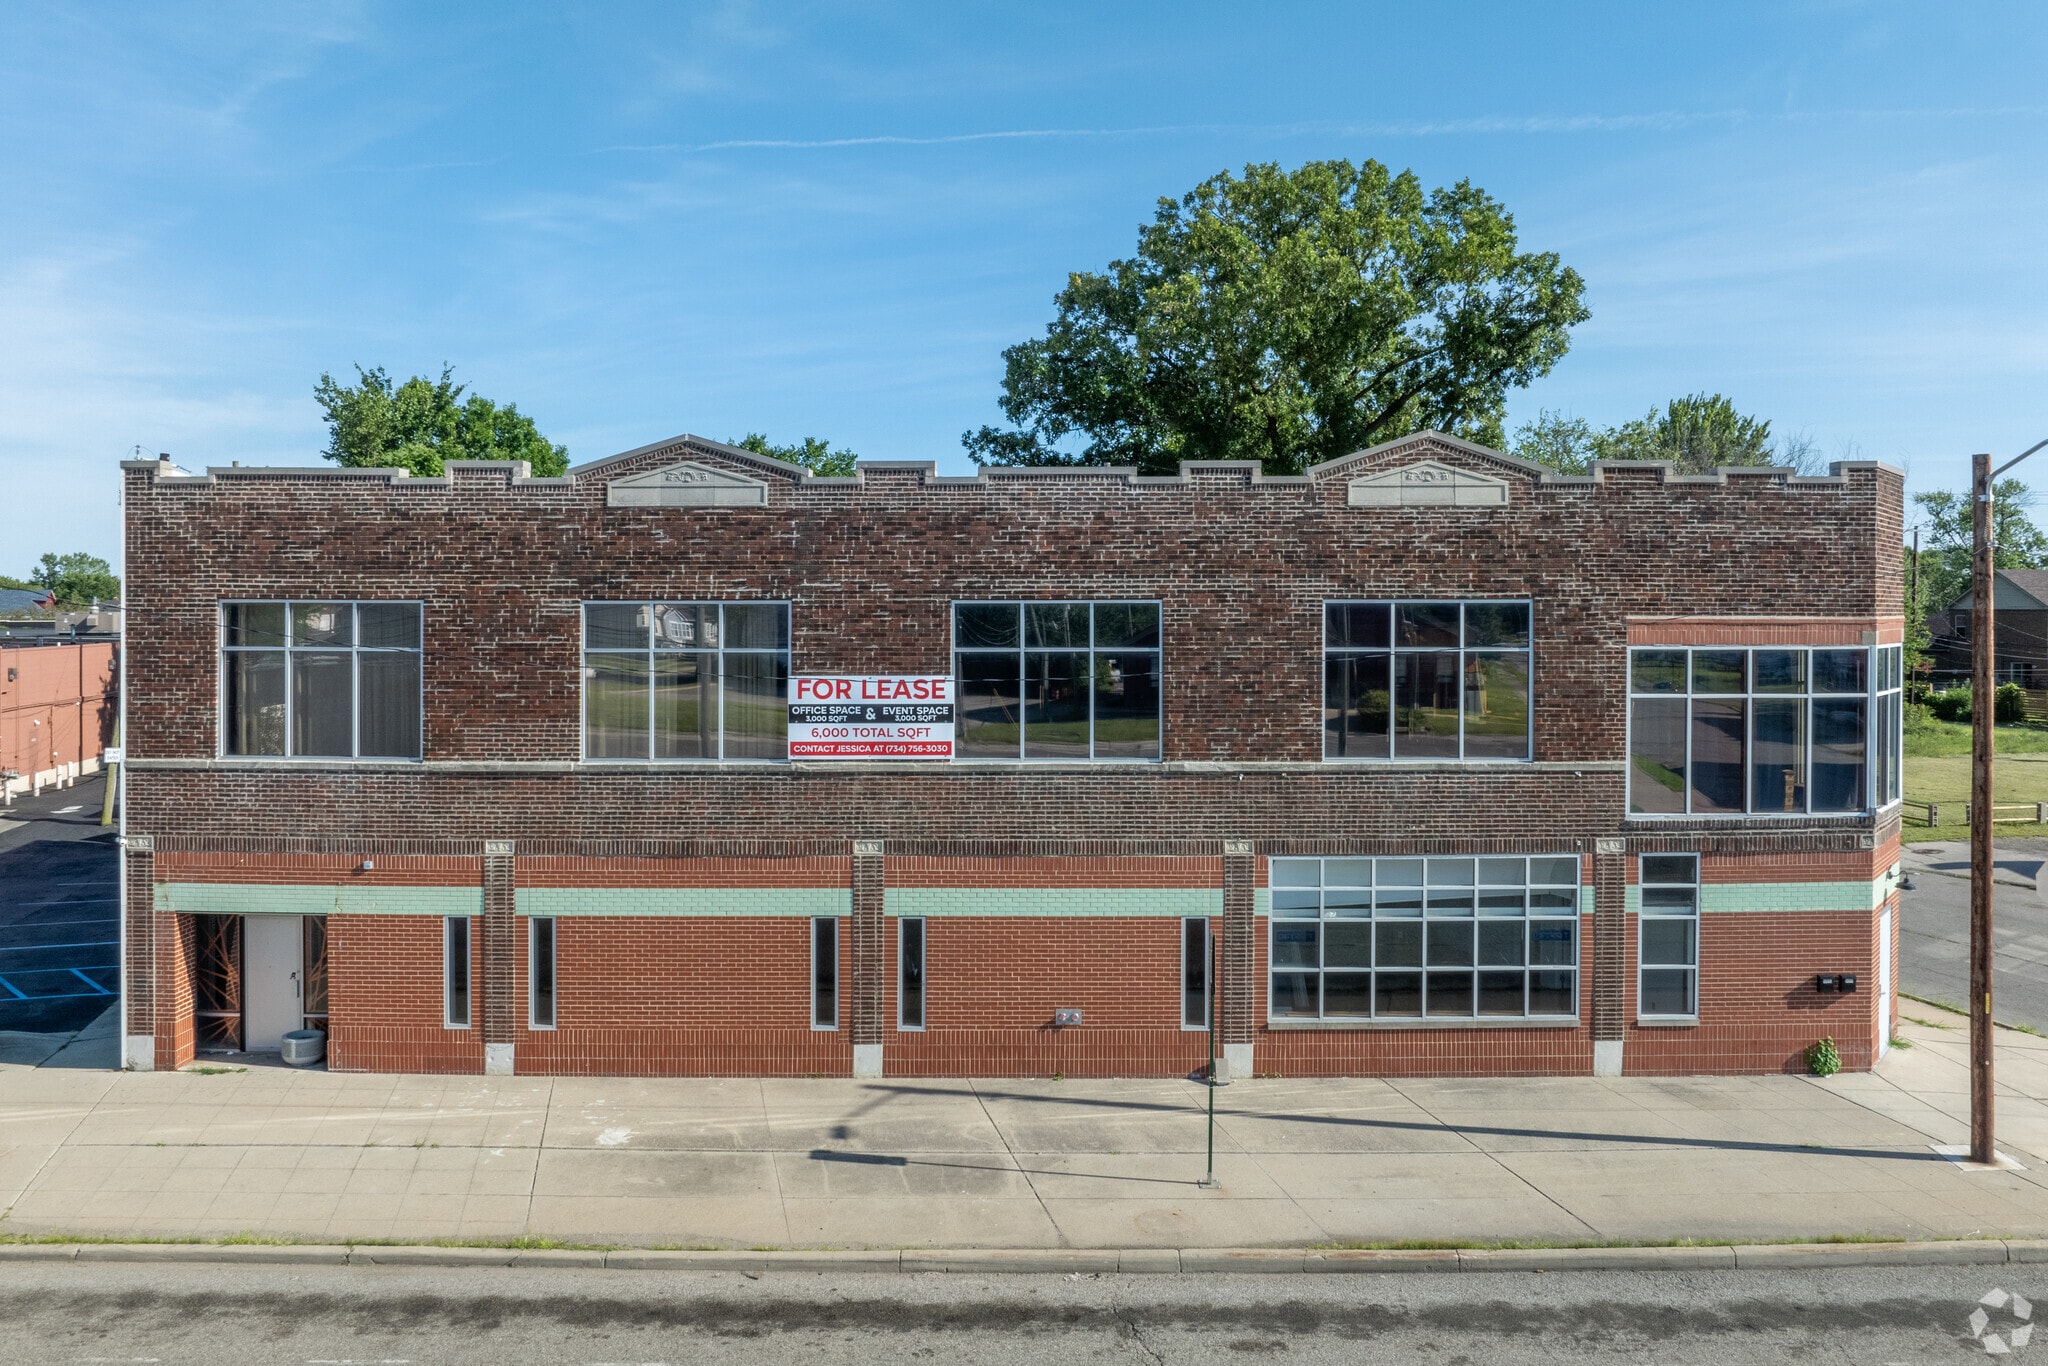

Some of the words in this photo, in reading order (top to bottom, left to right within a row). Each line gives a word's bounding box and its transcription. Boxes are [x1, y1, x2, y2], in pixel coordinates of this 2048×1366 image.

[797, 679, 852, 700] FOR
[861, 679, 946, 700] LEASE
[792, 706, 827, 715] OFFICE
[829, 706, 861, 715] SPACE
[865, 707, 876, 720] &
[883, 706, 915, 715] EVENT
[916, 706, 949, 715] SPACE
[895, 714, 916, 722] 3,000
[917, 714, 937, 722] SQFT
[811, 727, 849, 739] 6,000
[852, 727, 894, 738] TOTAL
[897, 727, 931, 739] SQFT
[793, 745, 835, 753] CONTACT
[836, 745, 871, 753] JESSICA
[885, 744, 907, 753] (734)
[908, 744, 948, 752] 756-3030
